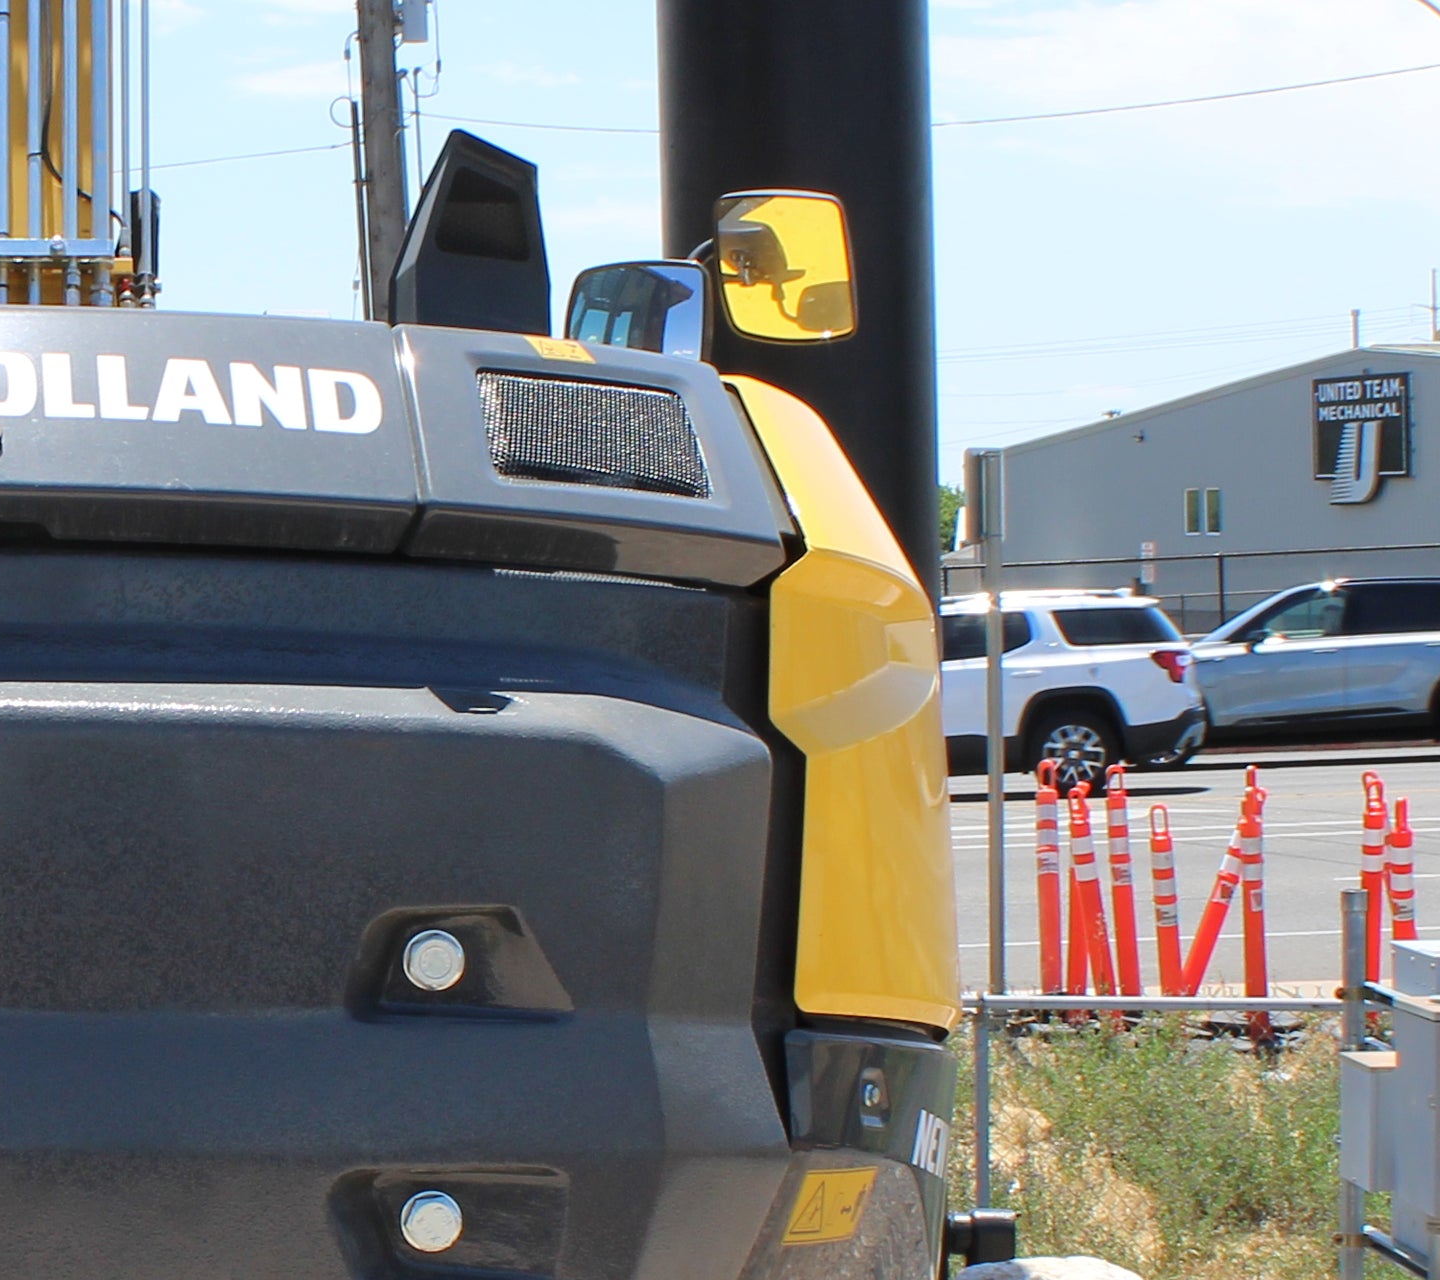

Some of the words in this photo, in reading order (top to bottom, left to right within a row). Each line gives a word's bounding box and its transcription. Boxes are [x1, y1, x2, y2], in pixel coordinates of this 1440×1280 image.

[1318, 381, 1362, 403] UNITED
[1363, 377, 1401, 400] TEAM
[1318, 402, 1402, 421] MECHANICAL
